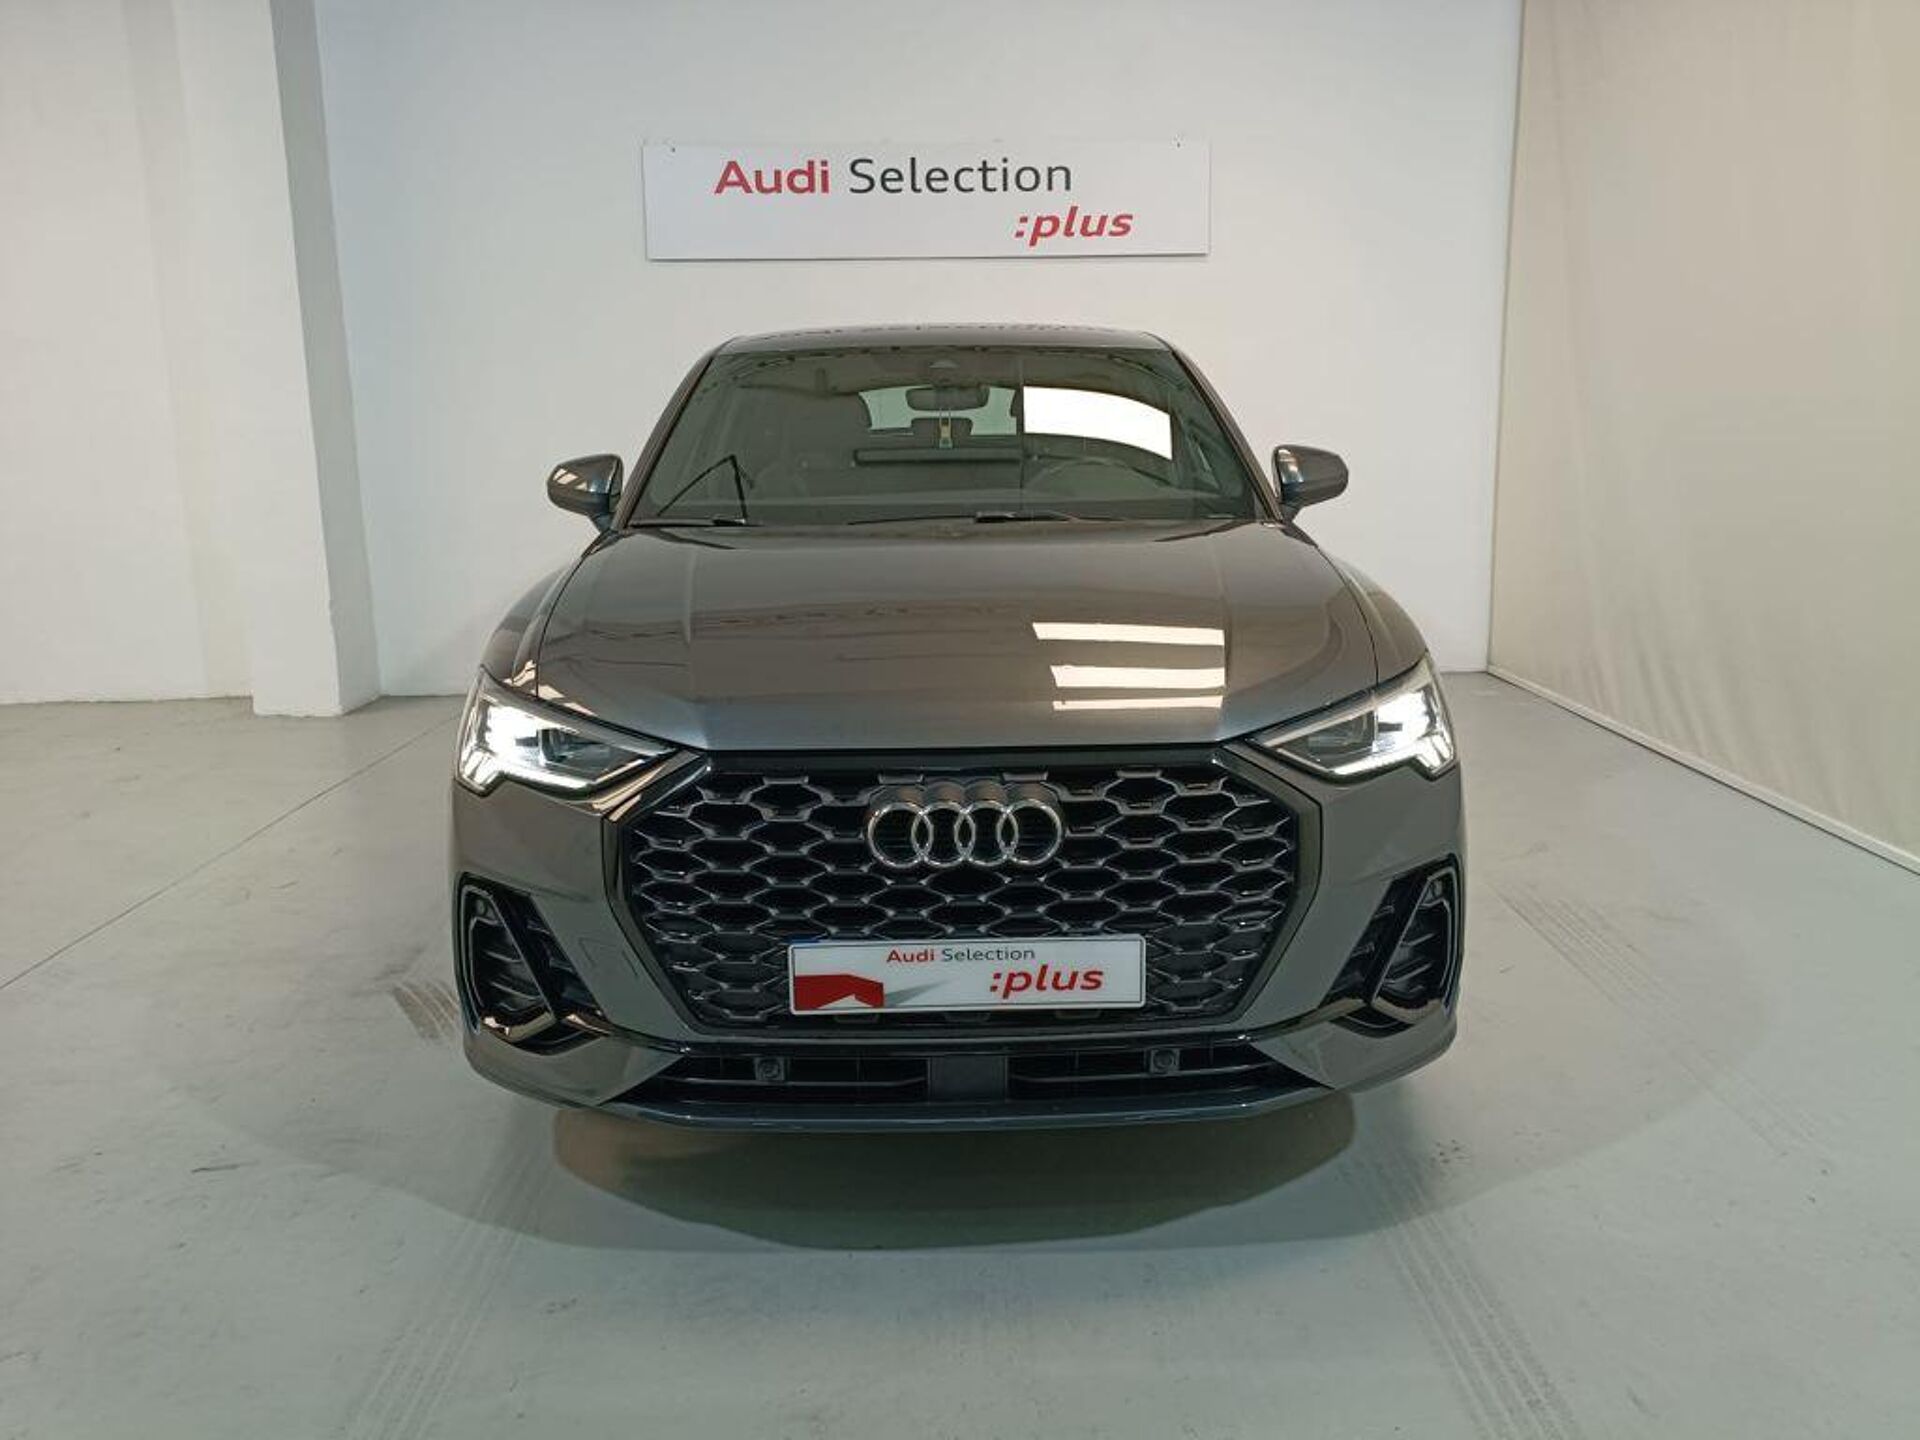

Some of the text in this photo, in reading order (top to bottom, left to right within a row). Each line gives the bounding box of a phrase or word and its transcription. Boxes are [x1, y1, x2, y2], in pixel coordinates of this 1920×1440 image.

[714, 157, 1073, 194] Audi Selection
[1014, 206, 1134, 246] :plus
[886, 948, 1036, 963] Audi Selection
[989, 964, 1104, 999] :plus
